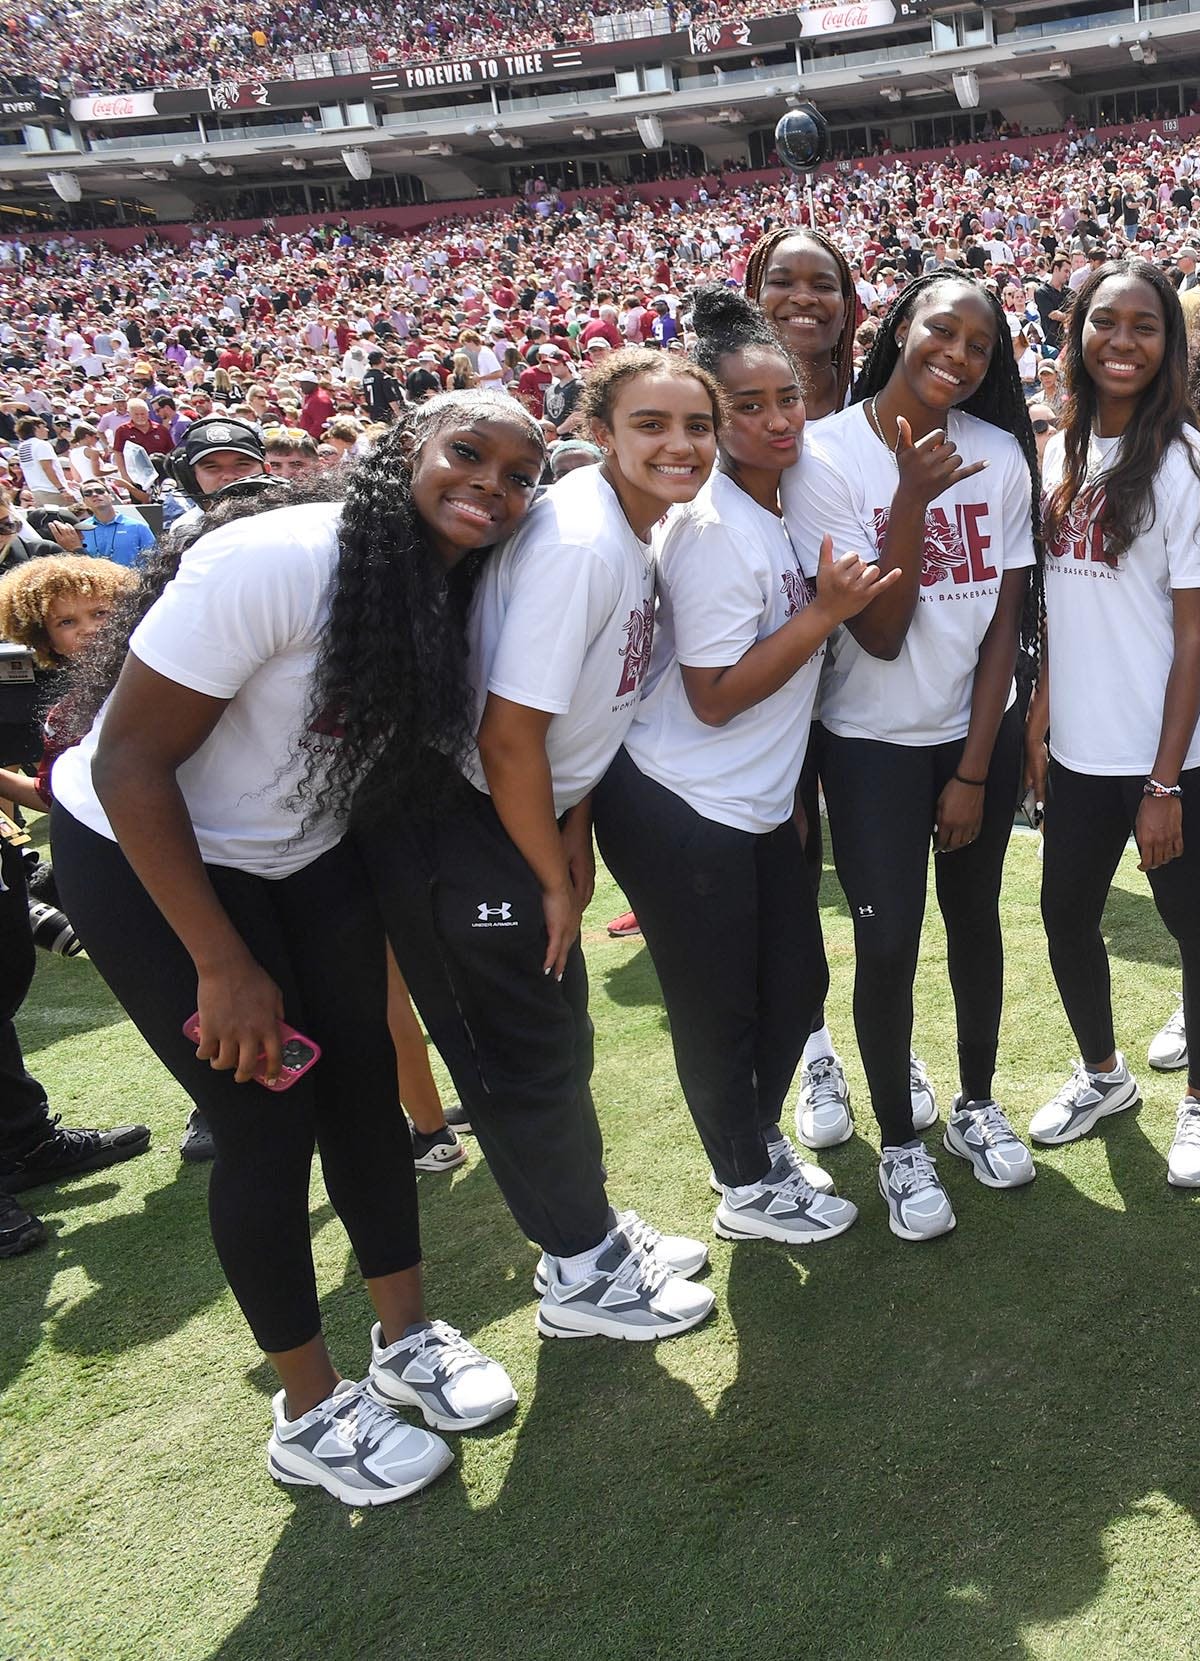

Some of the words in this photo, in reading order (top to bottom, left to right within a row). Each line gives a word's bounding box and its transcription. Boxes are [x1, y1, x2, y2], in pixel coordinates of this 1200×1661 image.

[821, 6, 868, 31] Coca-Cola
[405, 62, 472, 88] FOREVER
[478, 59, 499, 80] TO
[505, 53, 544, 76] THEE
[92, 98, 134, 117] Coca-Cola
[1164, 120, 1177, 131] 103
